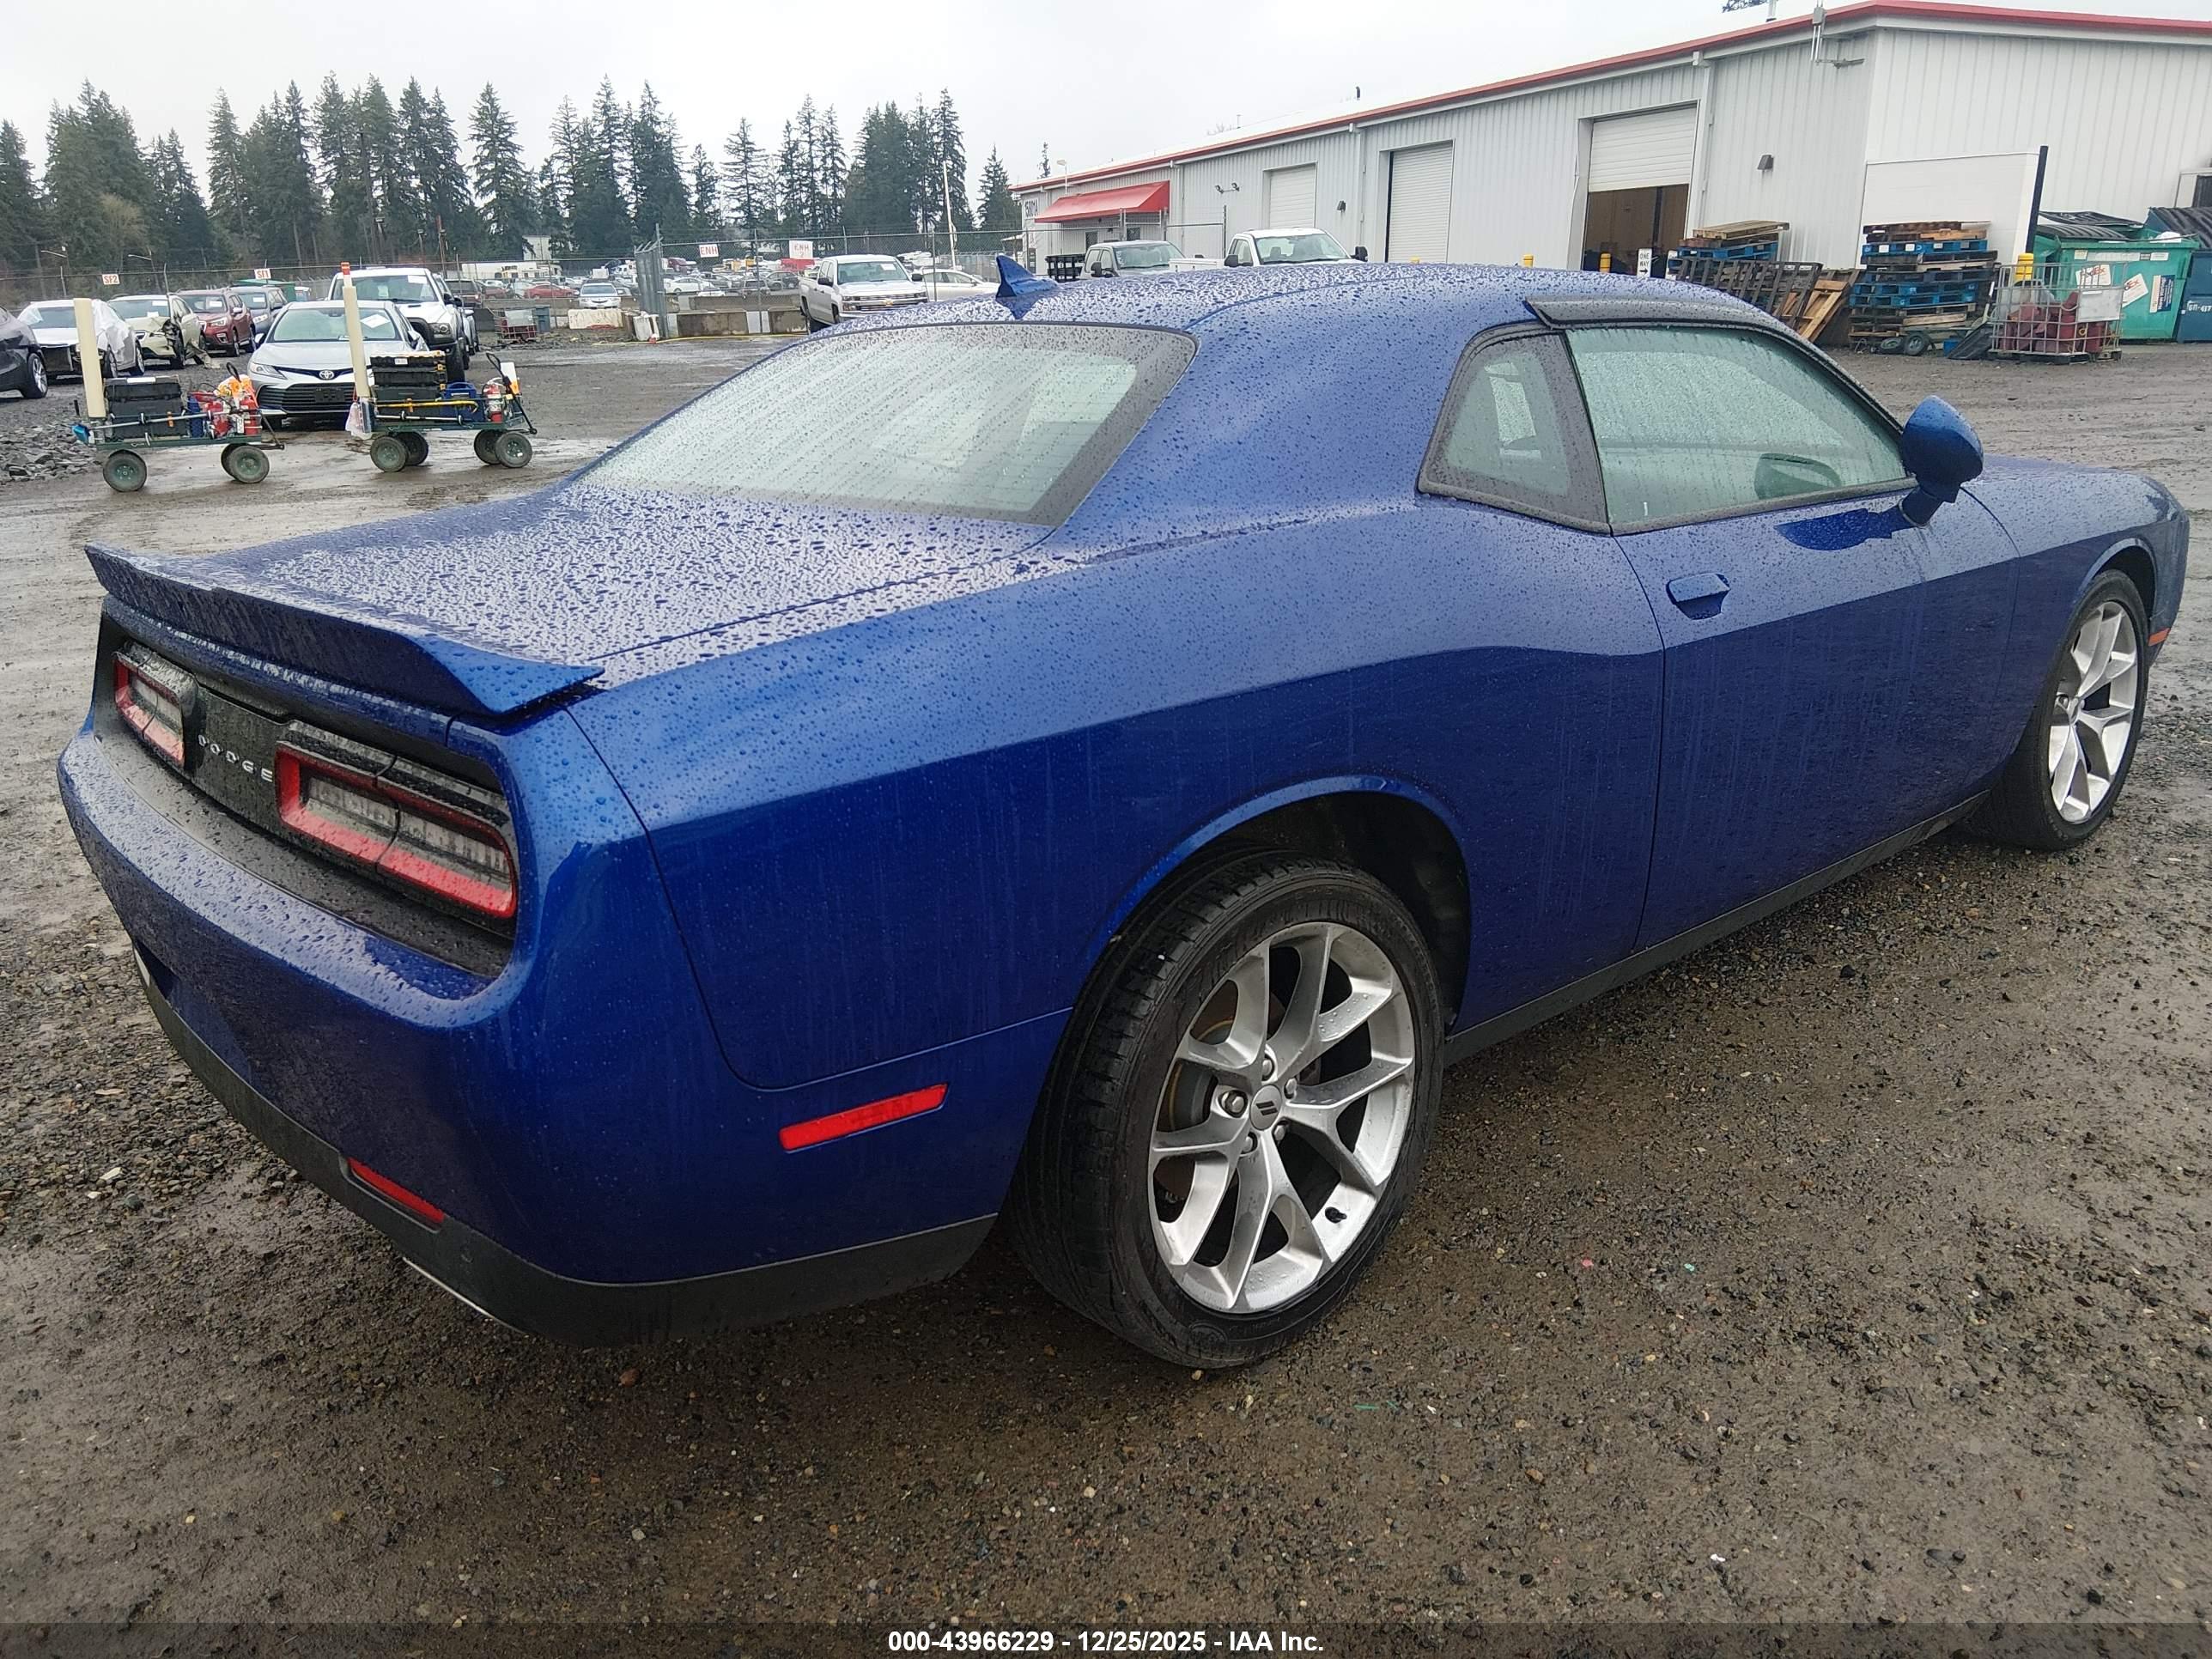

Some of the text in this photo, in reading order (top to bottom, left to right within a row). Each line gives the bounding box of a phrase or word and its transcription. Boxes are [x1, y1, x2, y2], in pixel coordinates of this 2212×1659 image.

[700, 245, 718, 256] ENH
[257, 270, 270, 278] SF1
[103, 275, 118, 283] SF2
[197, 733, 274, 783] DODGE
